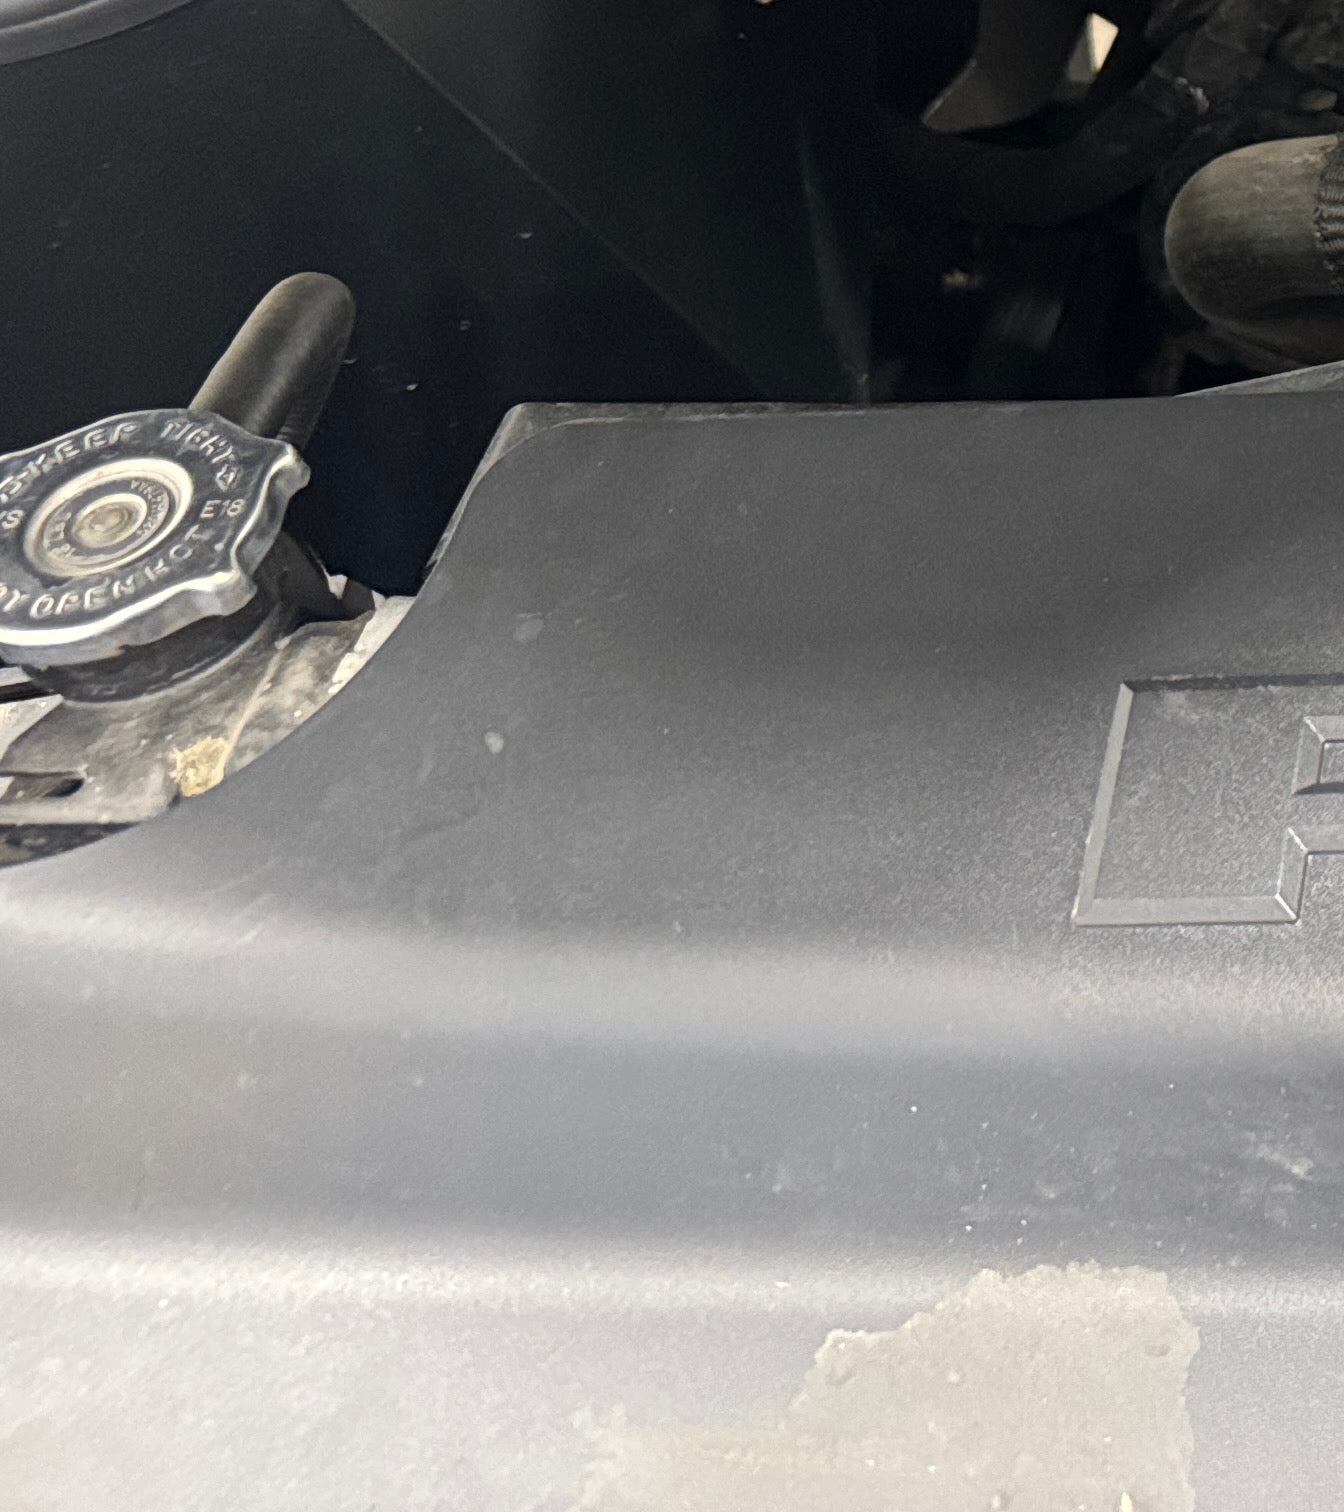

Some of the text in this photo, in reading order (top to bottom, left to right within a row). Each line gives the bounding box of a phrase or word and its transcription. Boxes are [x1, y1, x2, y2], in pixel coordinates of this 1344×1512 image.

[200, 499, 245, 519] E18
[30, 574, 135, 619] OPEN
[144, 524, 213, 582] HOT
